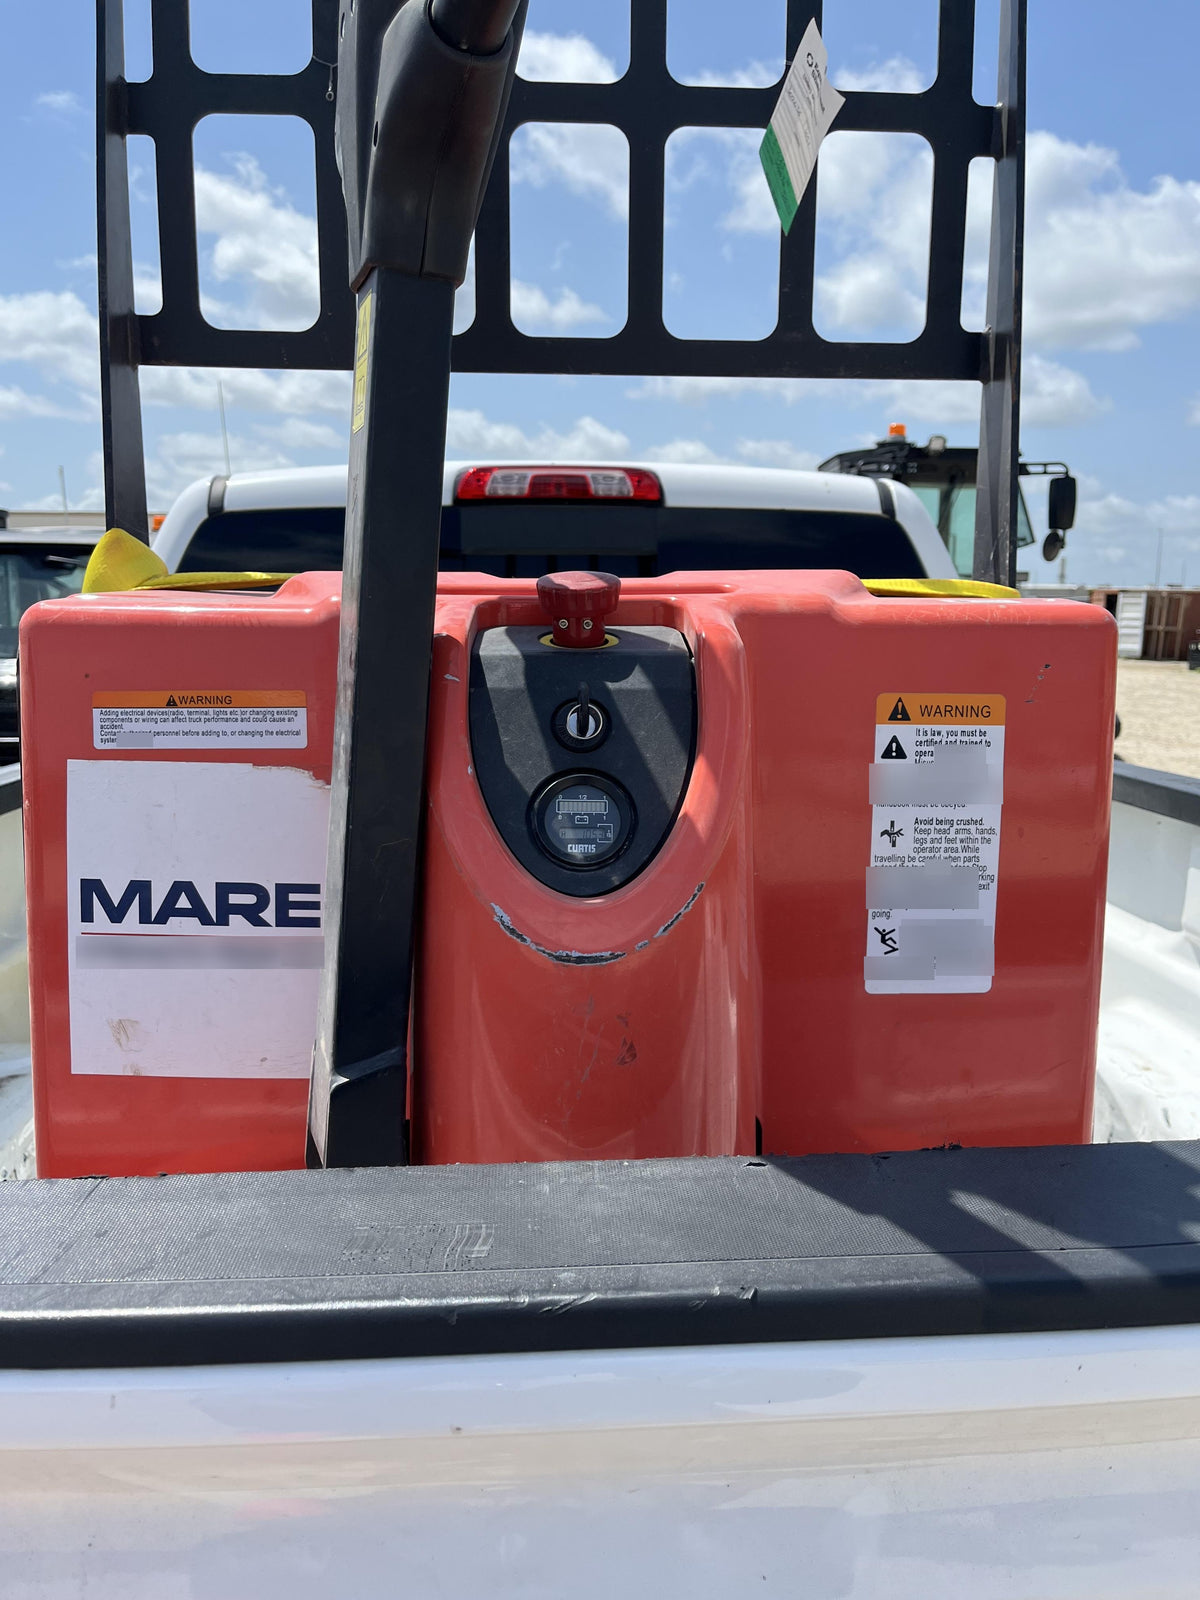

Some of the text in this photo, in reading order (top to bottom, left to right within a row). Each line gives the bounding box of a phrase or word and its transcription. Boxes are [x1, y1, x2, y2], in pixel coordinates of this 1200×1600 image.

[178, 696, 232, 705] WARNING
[920, 704, 992, 718] WARNING
[100, 716, 294, 724] components or wiring can affect truck performance and could cause an
[154, 730, 180, 738] personnel
[201, 730, 220, 738] adding
[238, 730, 264, 738] changing
[916, 728, 987, 738] It is law, you must be
[915, 738, 942, 747] certified
[984, 740, 991, 748] to
[914, 817, 984, 827] Avoid being crushed.
[914, 826, 931, 836] Keep
[955, 828, 973, 836] arms,
[976, 827, 998, 836] hands,
[914, 836, 991, 846] legs and feet within the
[568, 844, 596, 852] CURTIS
[913, 845, 942, 854] operator
[874, 854, 905, 863] travelling
[908, 854, 916, 863] be
[963, 855, 980, 864] parts
[80, 878, 321, 928] MARE
[872, 910, 892, 920] going.
